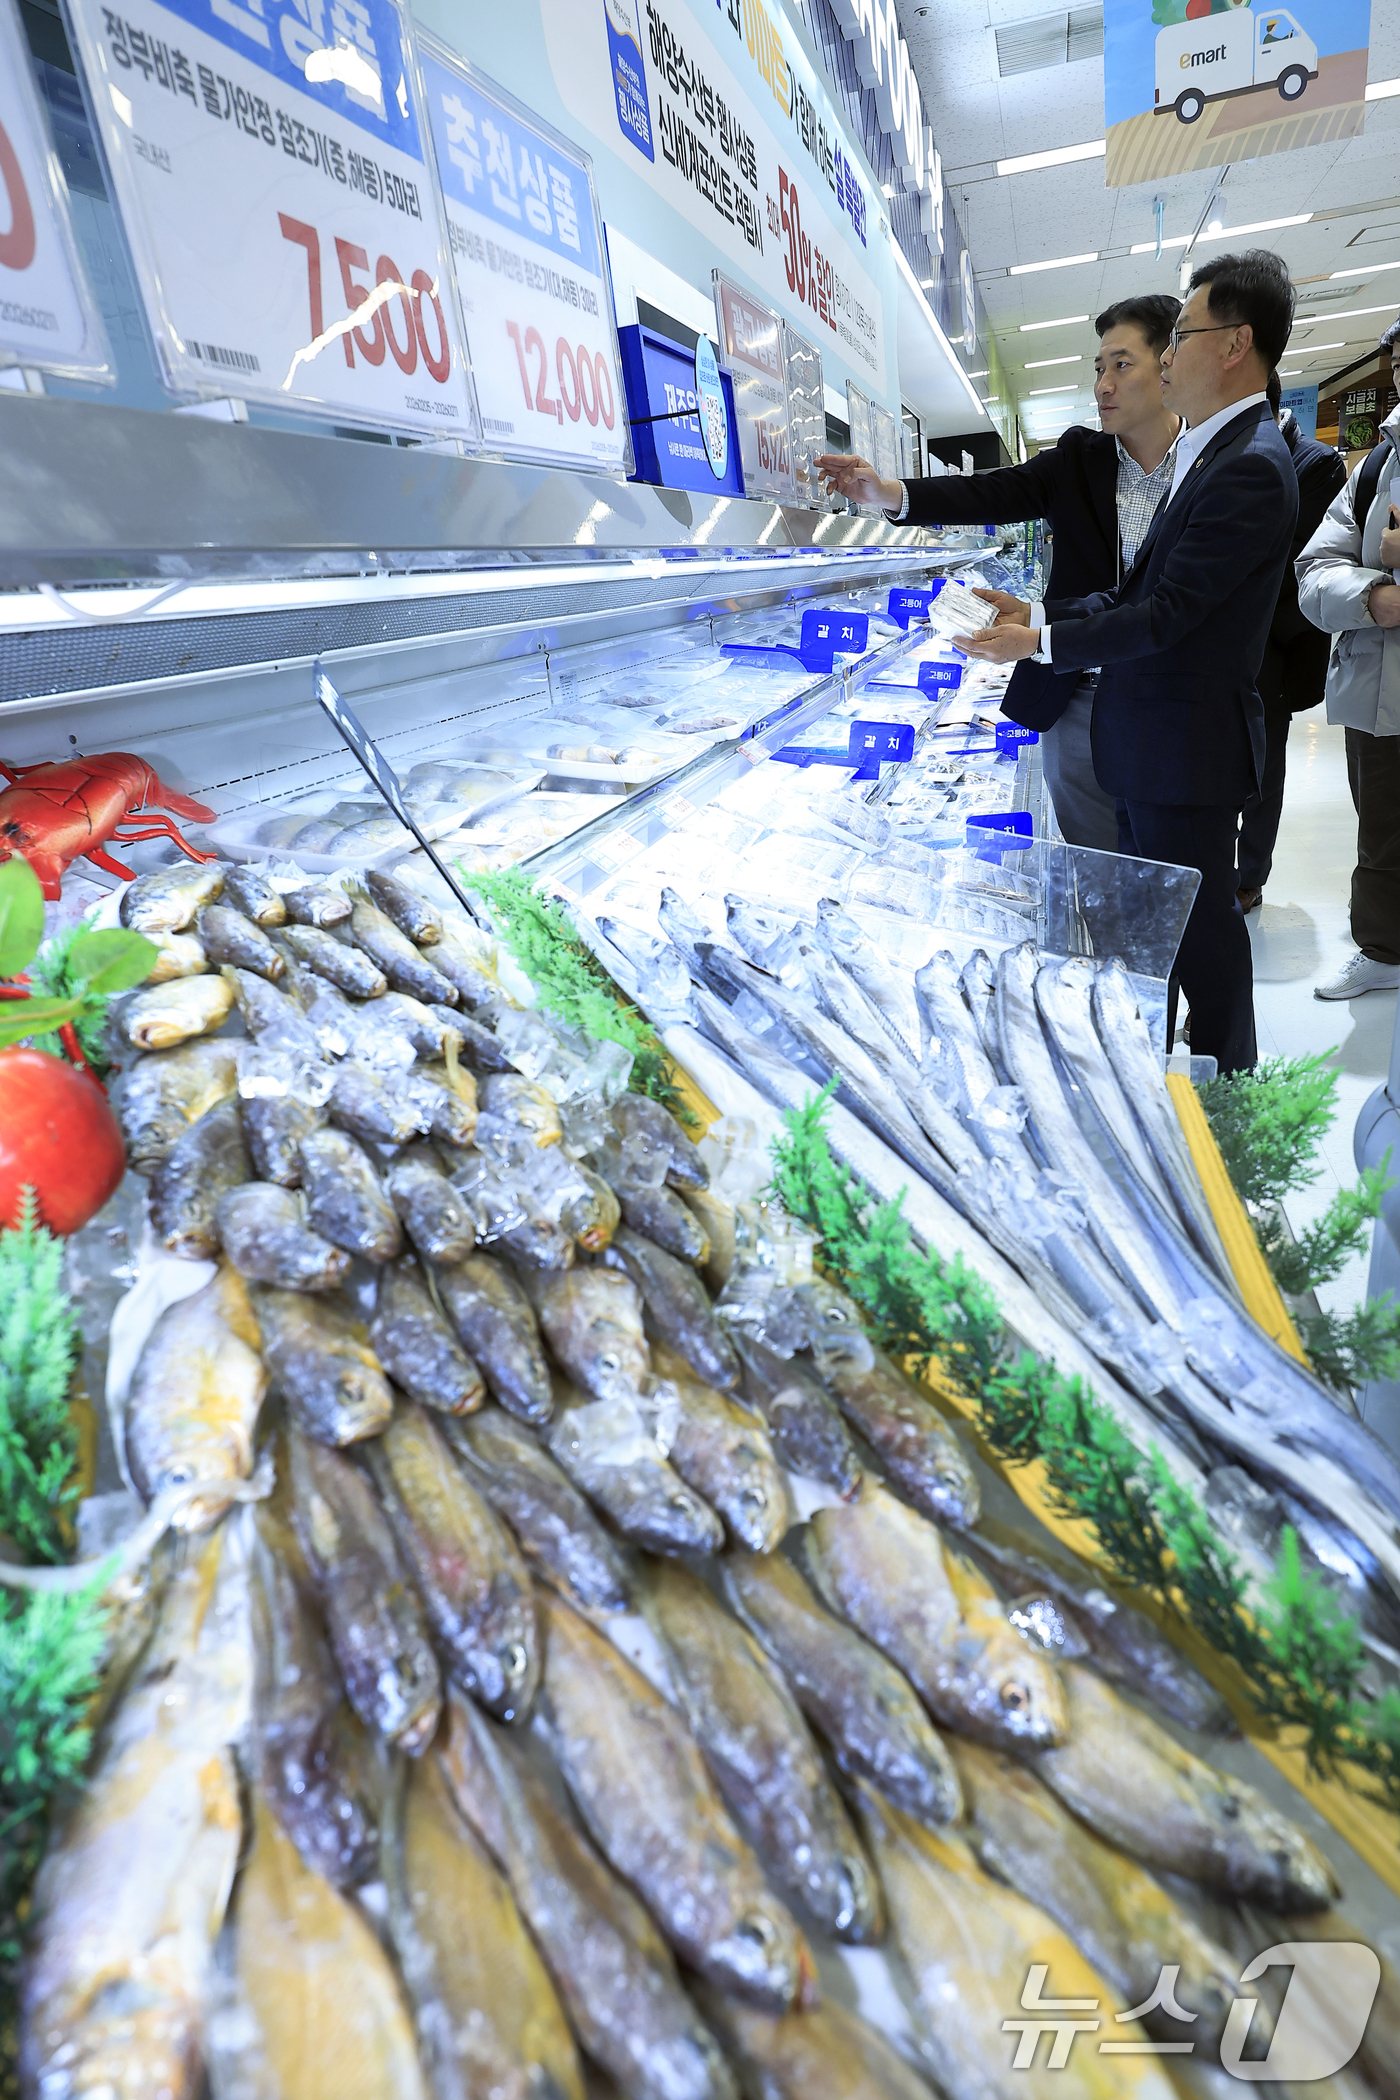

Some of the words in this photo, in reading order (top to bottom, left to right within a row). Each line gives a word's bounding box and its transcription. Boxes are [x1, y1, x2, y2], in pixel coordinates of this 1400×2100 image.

[1179, 44, 1227, 69] emart
[102, 8, 199, 108] 정부비축
[196, 62, 276, 147] 물가안정
[386, 171, 423, 222] 5마리
[617, 86, 650, 145] 행사상품
[646, 0, 717, 138] 해양수산부
[716, 92, 759, 191] 행사상품
[440, 92, 582, 254] 추천상품
[659, 94, 735, 225] 신세계포인트
[505, 319, 615, 431] 12,000
[1345, 390, 1377, 404] 시금치
[1345, 402, 1376, 415] 보물초
[898, 598, 922, 608] 고등어
[927, 670, 952, 681] 고등어
[1006, 728, 1030, 738] 고등어
